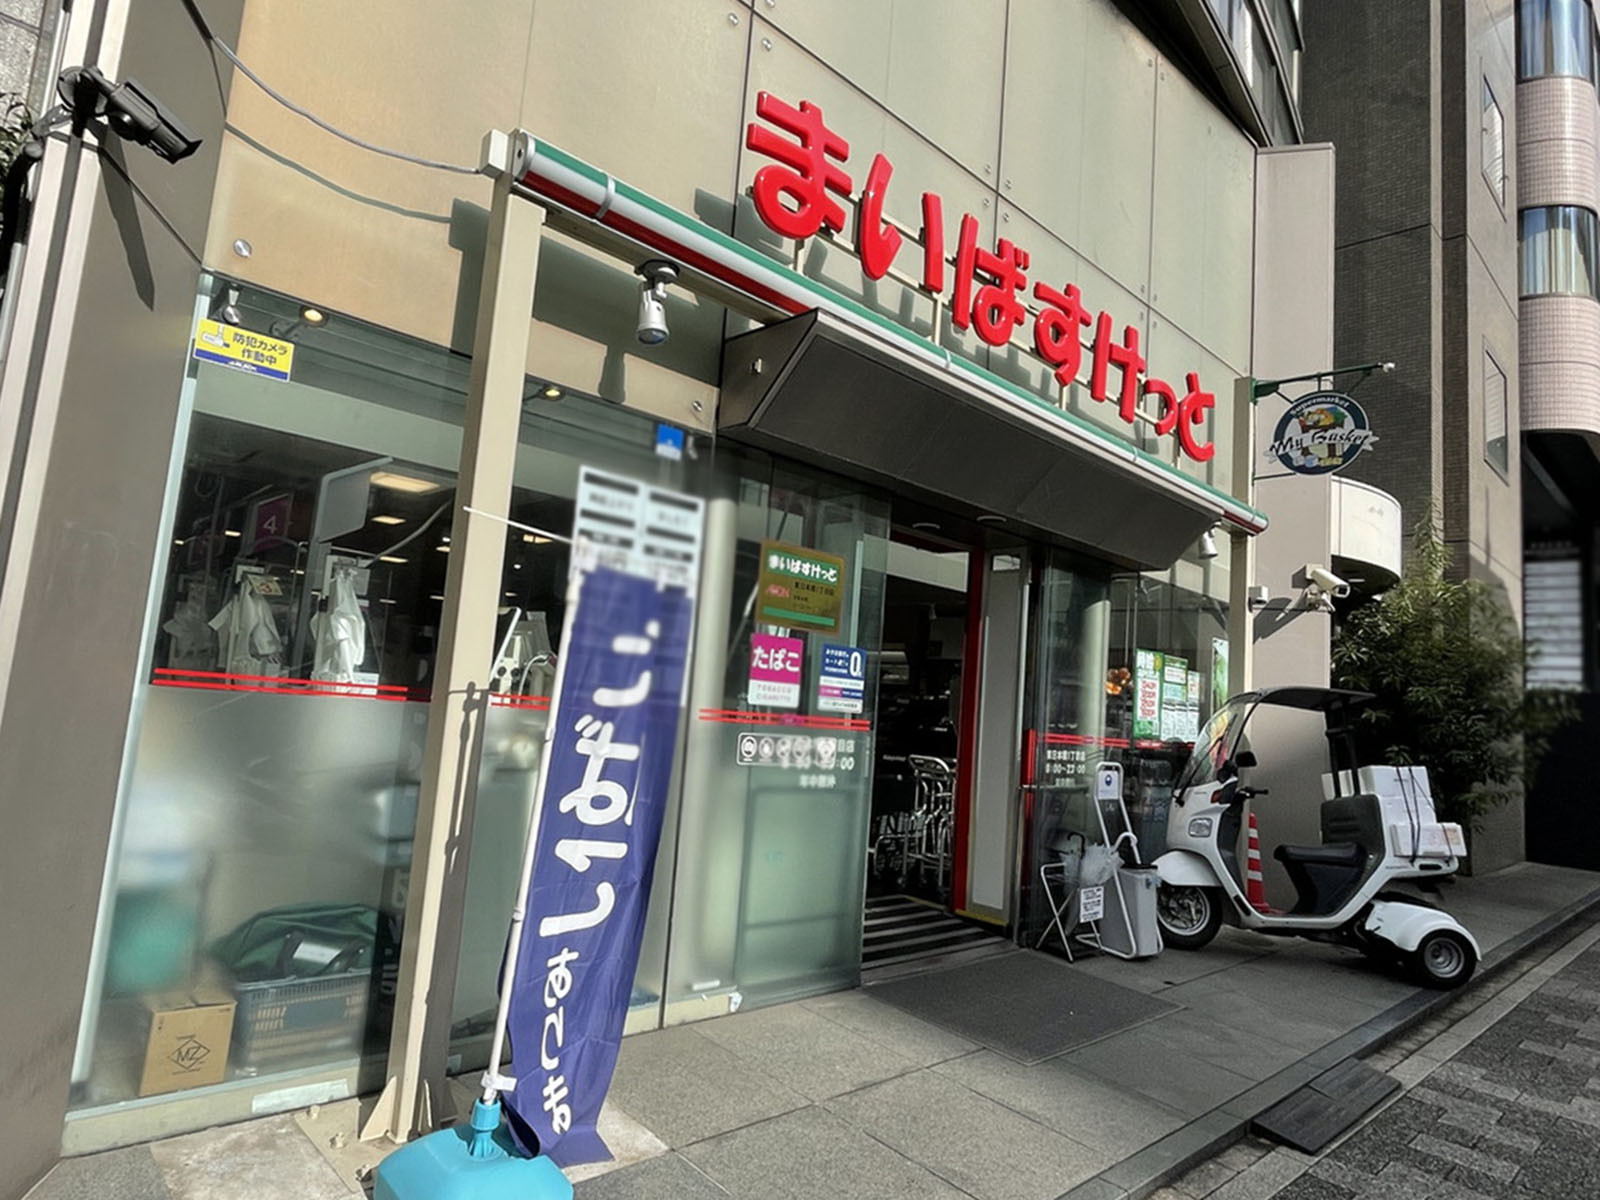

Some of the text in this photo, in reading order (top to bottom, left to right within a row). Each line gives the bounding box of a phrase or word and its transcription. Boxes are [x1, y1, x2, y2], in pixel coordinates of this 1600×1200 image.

[747, 91, 1215, 462] まいばすけっと
[233, 332, 288, 356] 防犯カメラ
[1270, 428, 1370, 455] My Basket
[264, 515, 277, 534] 4
[752, 645, 800, 672] たばこ
